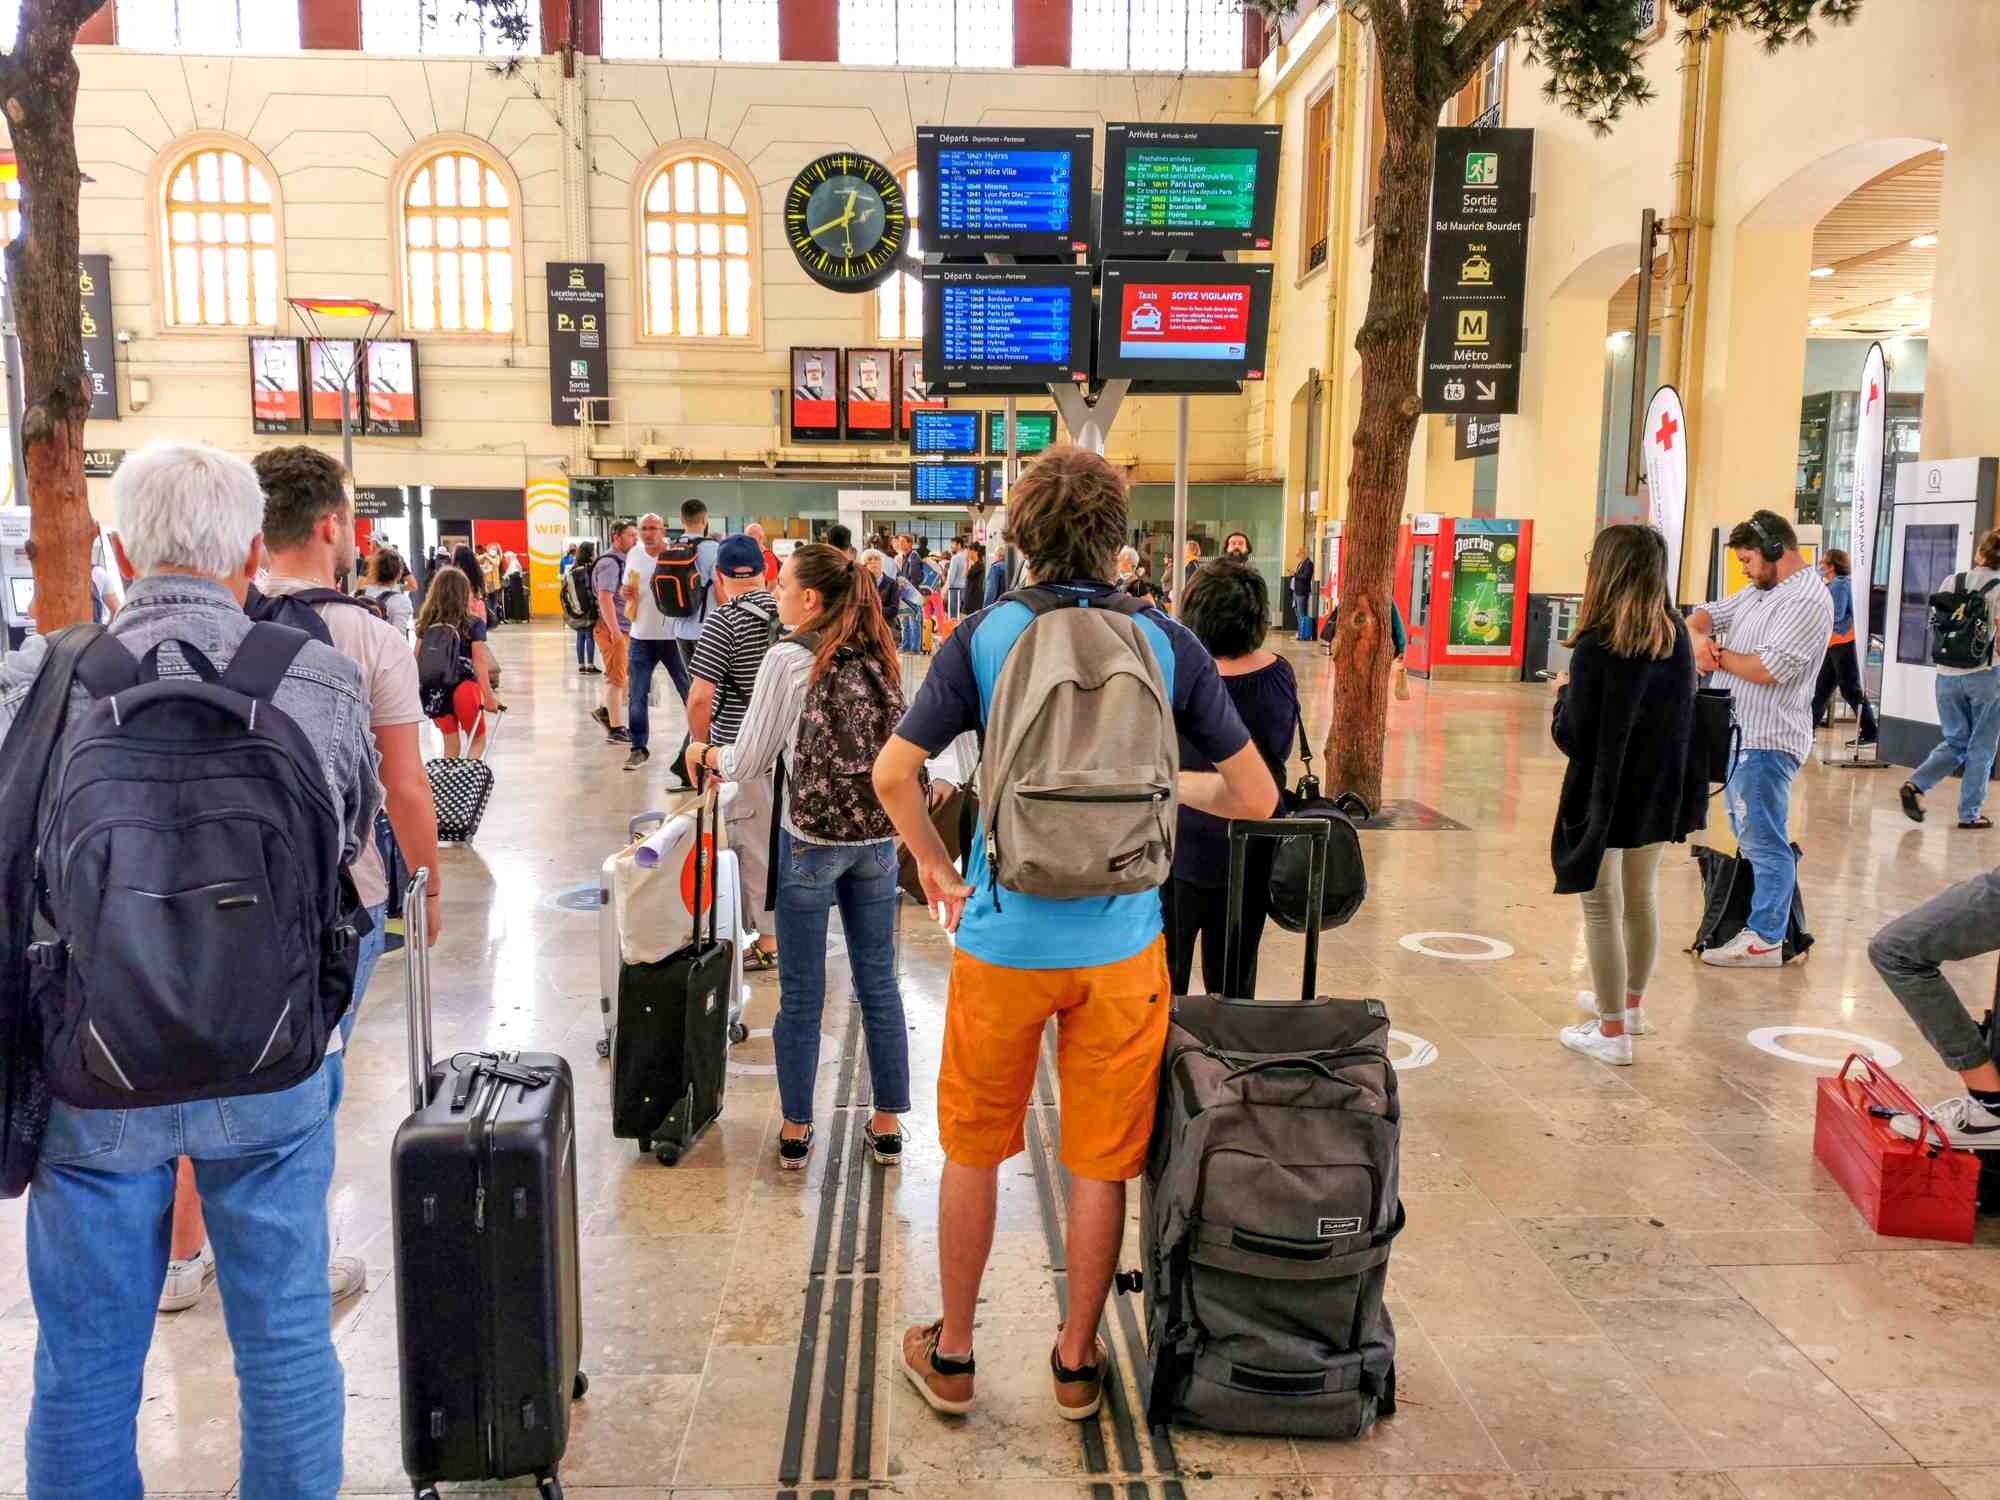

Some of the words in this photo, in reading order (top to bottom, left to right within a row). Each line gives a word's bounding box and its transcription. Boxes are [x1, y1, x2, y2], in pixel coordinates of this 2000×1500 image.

[939, 133, 969, 146] Départs
[1128, 130, 1158, 140] Arrivées
[984, 168, 1000, 176] Nice
[1001, 167, 1017, 176] Ville
[1190, 165, 1206, 173] Lyon
[1188, 181, 1205, 189] Lyon
[984, 191, 997, 199] Lyon
[1463, 193, 1497, 206] Sortie
[1436, 221, 1448, 231] Bd
[1450, 221, 1485, 231] Maurice
[1486, 221, 1521, 232] Bourdet
[1468, 244, 1487, 252] Taxis
[944, 272, 972, 281] Départs
[1171, 291, 1199, 300] SOYEZ
[1201, 292, 1243, 300] VIGILANTS
[1463, 317, 1482, 335] M
[1454, 349, 1488, 362] Métro
[84, 454, 114, 465] AUL
